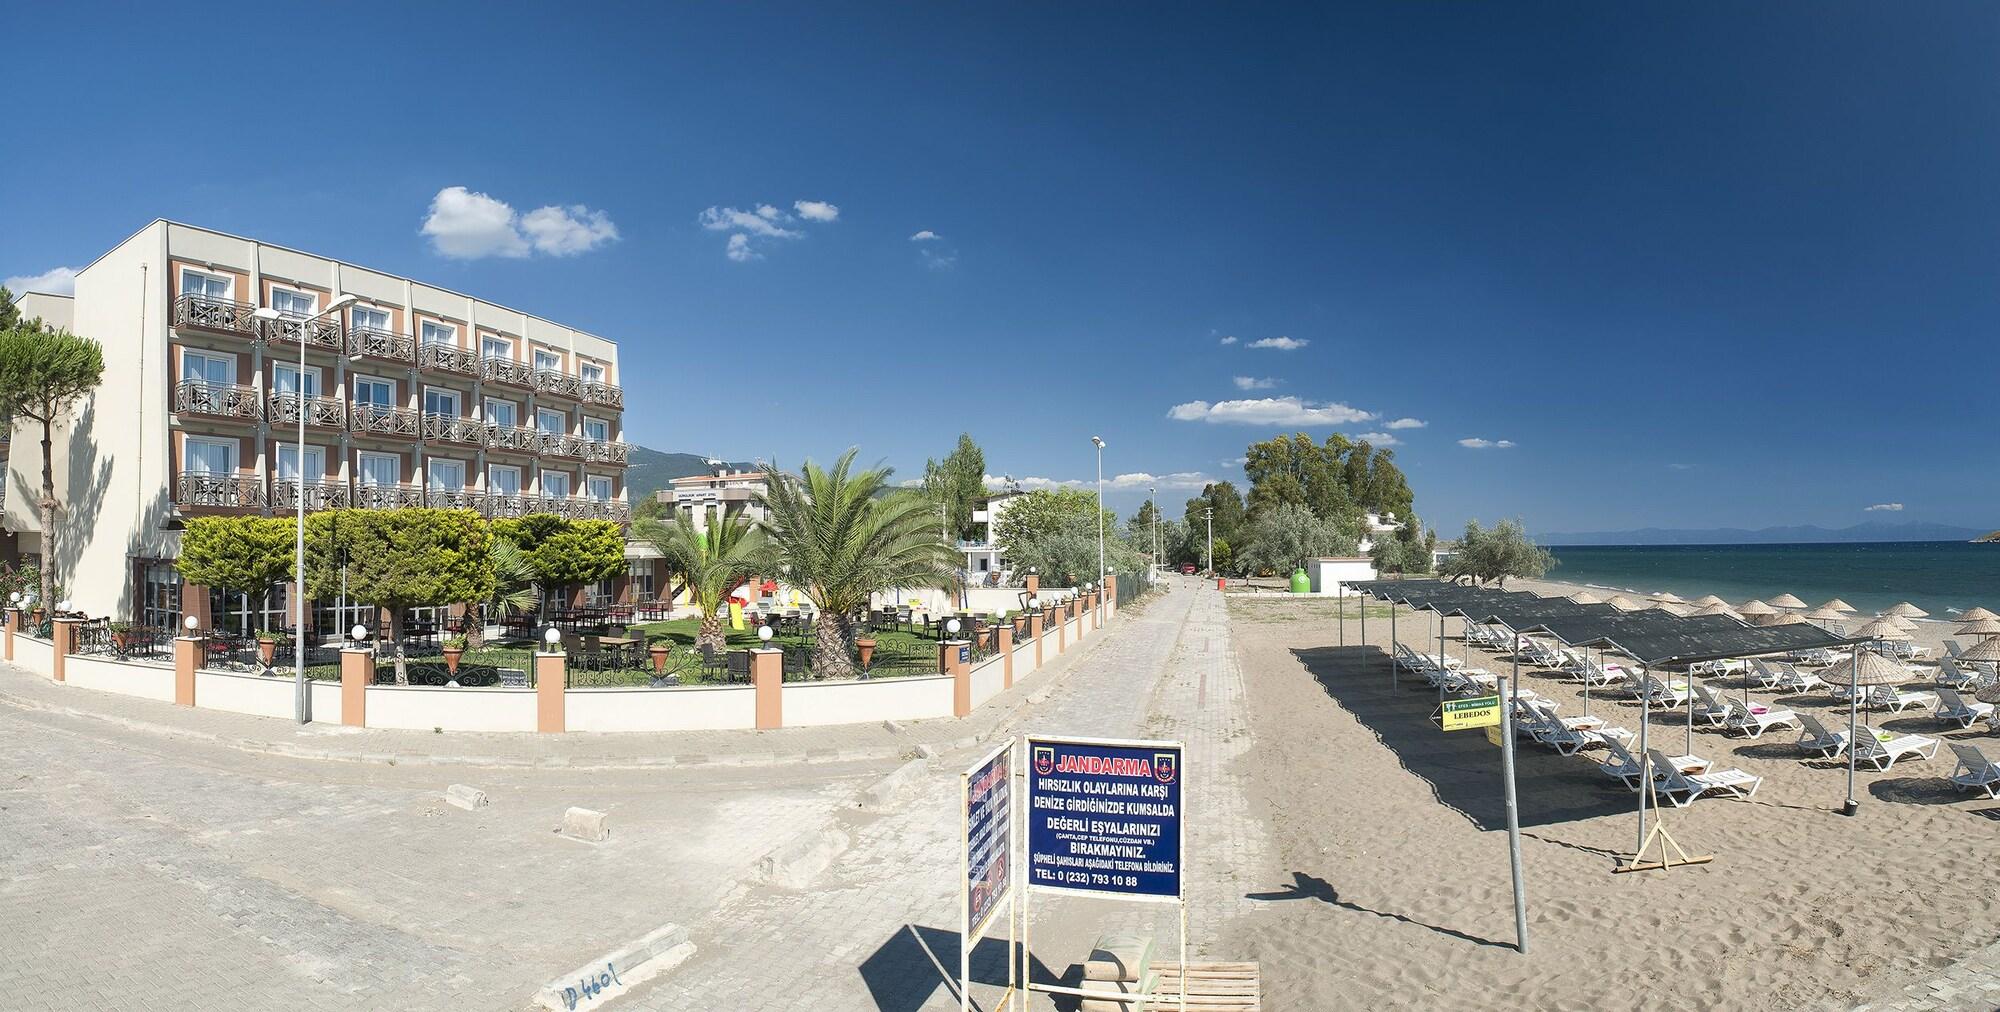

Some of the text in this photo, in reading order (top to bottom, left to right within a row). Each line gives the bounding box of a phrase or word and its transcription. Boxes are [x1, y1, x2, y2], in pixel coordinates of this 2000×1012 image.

[1454, 710, 1491, 719] LEBEDOS
[1057, 755, 1152, 777] JANDARMA
[1038, 778, 1168, 800] HIRSIZLIK OLAYLARINA KARŞI
[1034, 795, 1174, 817] DENİZE GİRDİĞİNİZDE KUMSALDA
[1047, 815, 1160, 836] DEĞERLİ EŞYALARINIZI
[1070, 842, 1146, 858] BIRAKMAYINIZ.
[1033, 852, 1175, 873] ŞÜPHELİ ŞAHISLARI AŞAĞIDAKİ TELEFONA BİLDİRİNİZ.
[1035, 868, 1138, 887] TEL: 0 (232) 793 10 88
